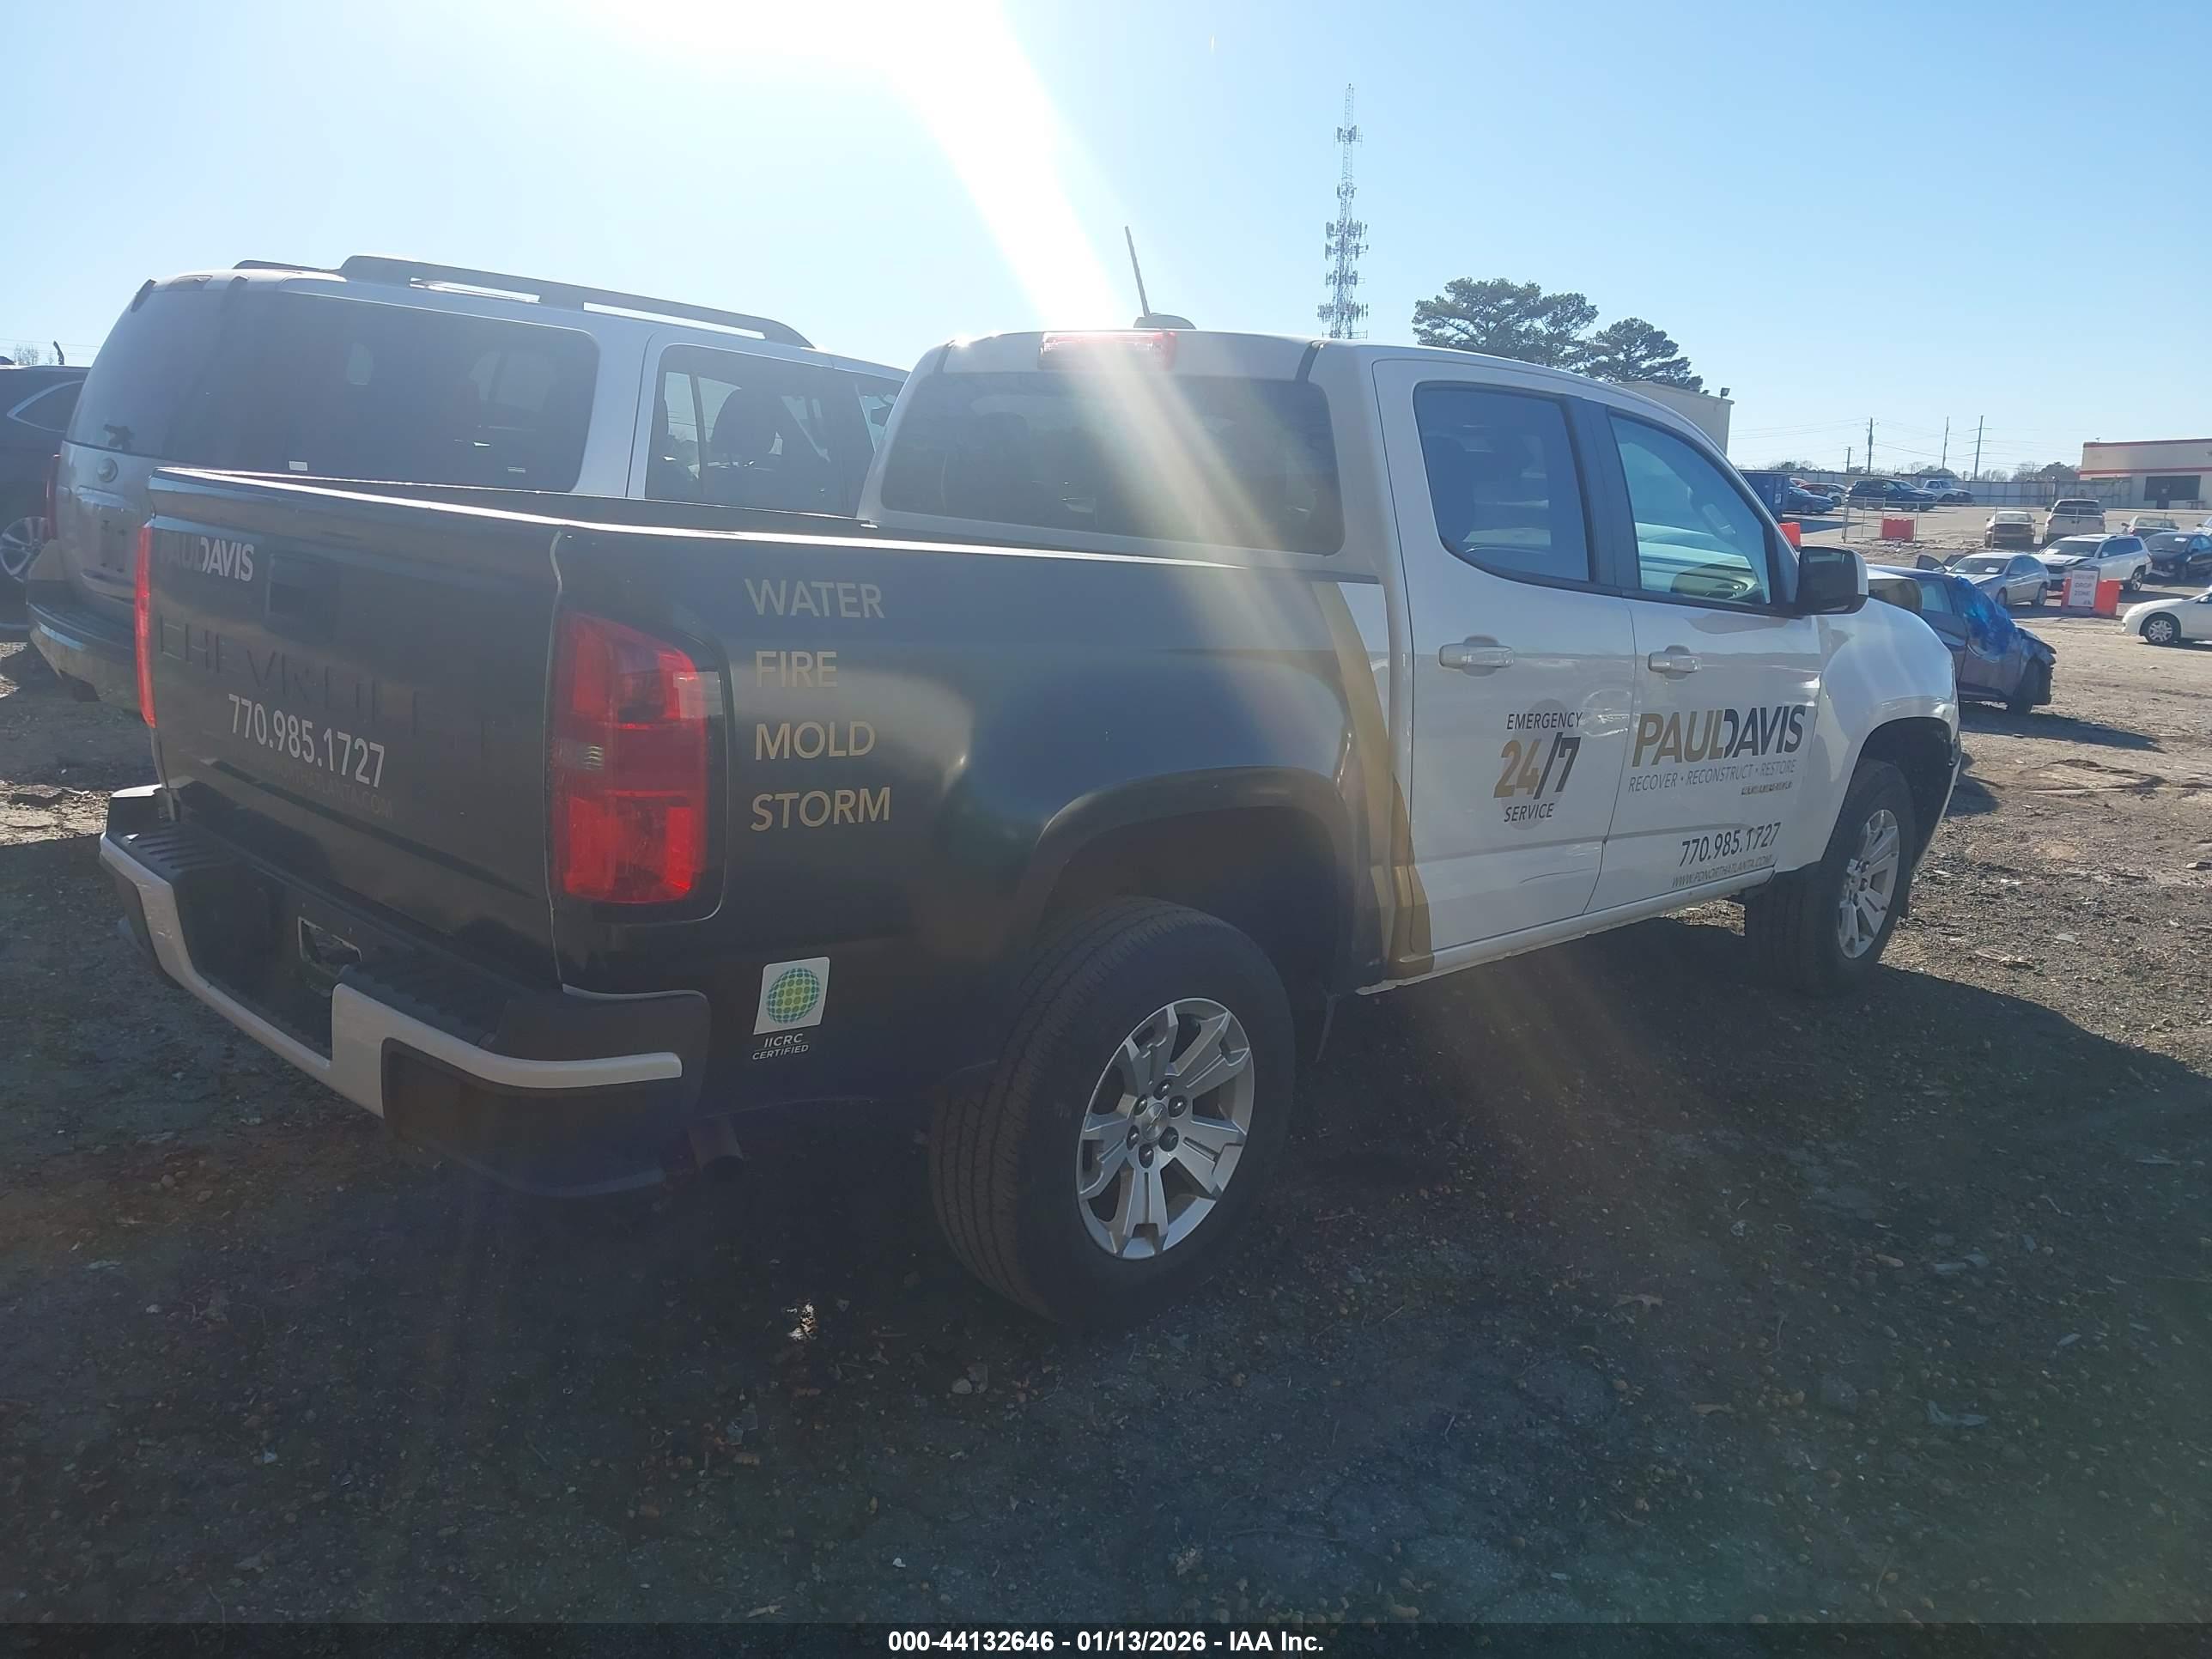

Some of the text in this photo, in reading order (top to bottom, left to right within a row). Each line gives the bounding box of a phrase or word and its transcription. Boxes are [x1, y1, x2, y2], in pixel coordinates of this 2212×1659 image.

[744, 578, 885, 619] WATER
[755, 650, 838, 689] FIRE
[228, 694, 386, 788] 770.985.1727
[754, 720, 876, 762] MOLD
[1506, 711, 1583, 730] EMERGENCY
[1632, 705, 1806, 768] PAULDAVIS
[1492, 732, 1582, 799] 24/7
[1628, 759, 1797, 793] RECOVER RECONSTRUCT RESTORE
[750, 787, 892, 832] STORM
[1504, 802, 1554, 823] SERVICE
[1679, 822, 1782, 867] 770.985.1727
[751, 1042, 810, 1060] CERTIFIED
[763, 1032, 804, 1048] IICRC
